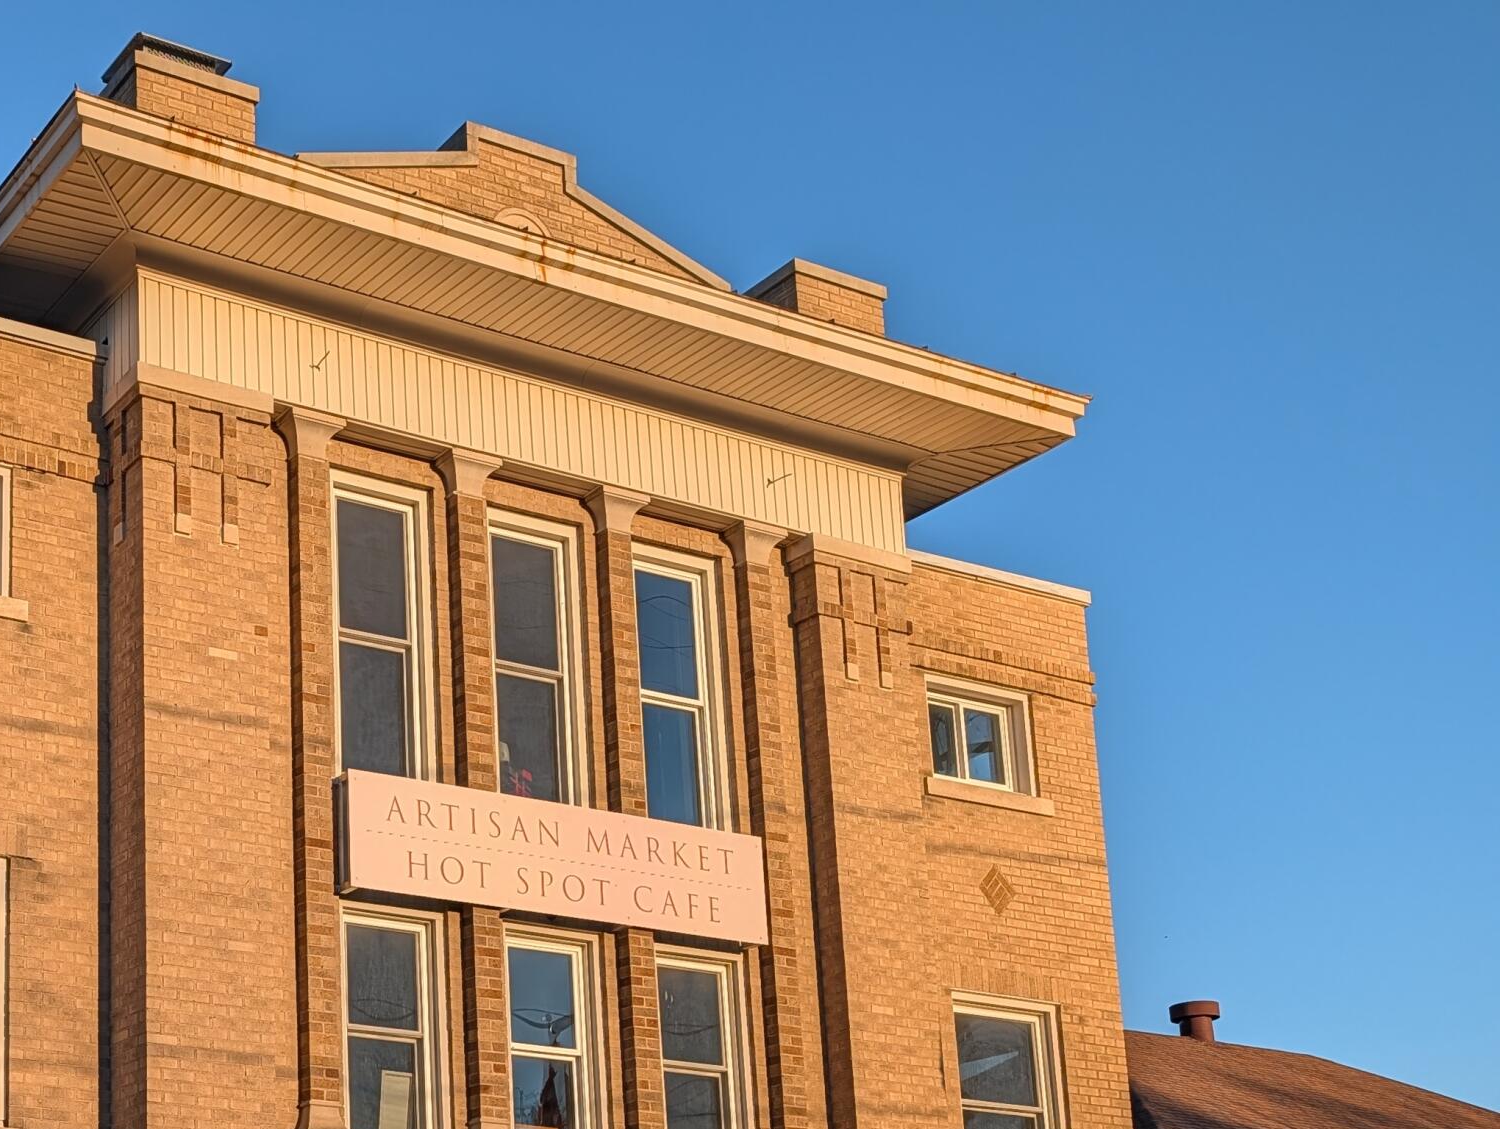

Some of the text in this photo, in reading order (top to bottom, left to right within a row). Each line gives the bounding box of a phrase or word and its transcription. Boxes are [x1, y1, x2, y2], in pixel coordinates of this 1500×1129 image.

[386, 795, 735, 875] ARTISAN MARKET
[407, 850, 722, 924] HOT SPOT CAFE
